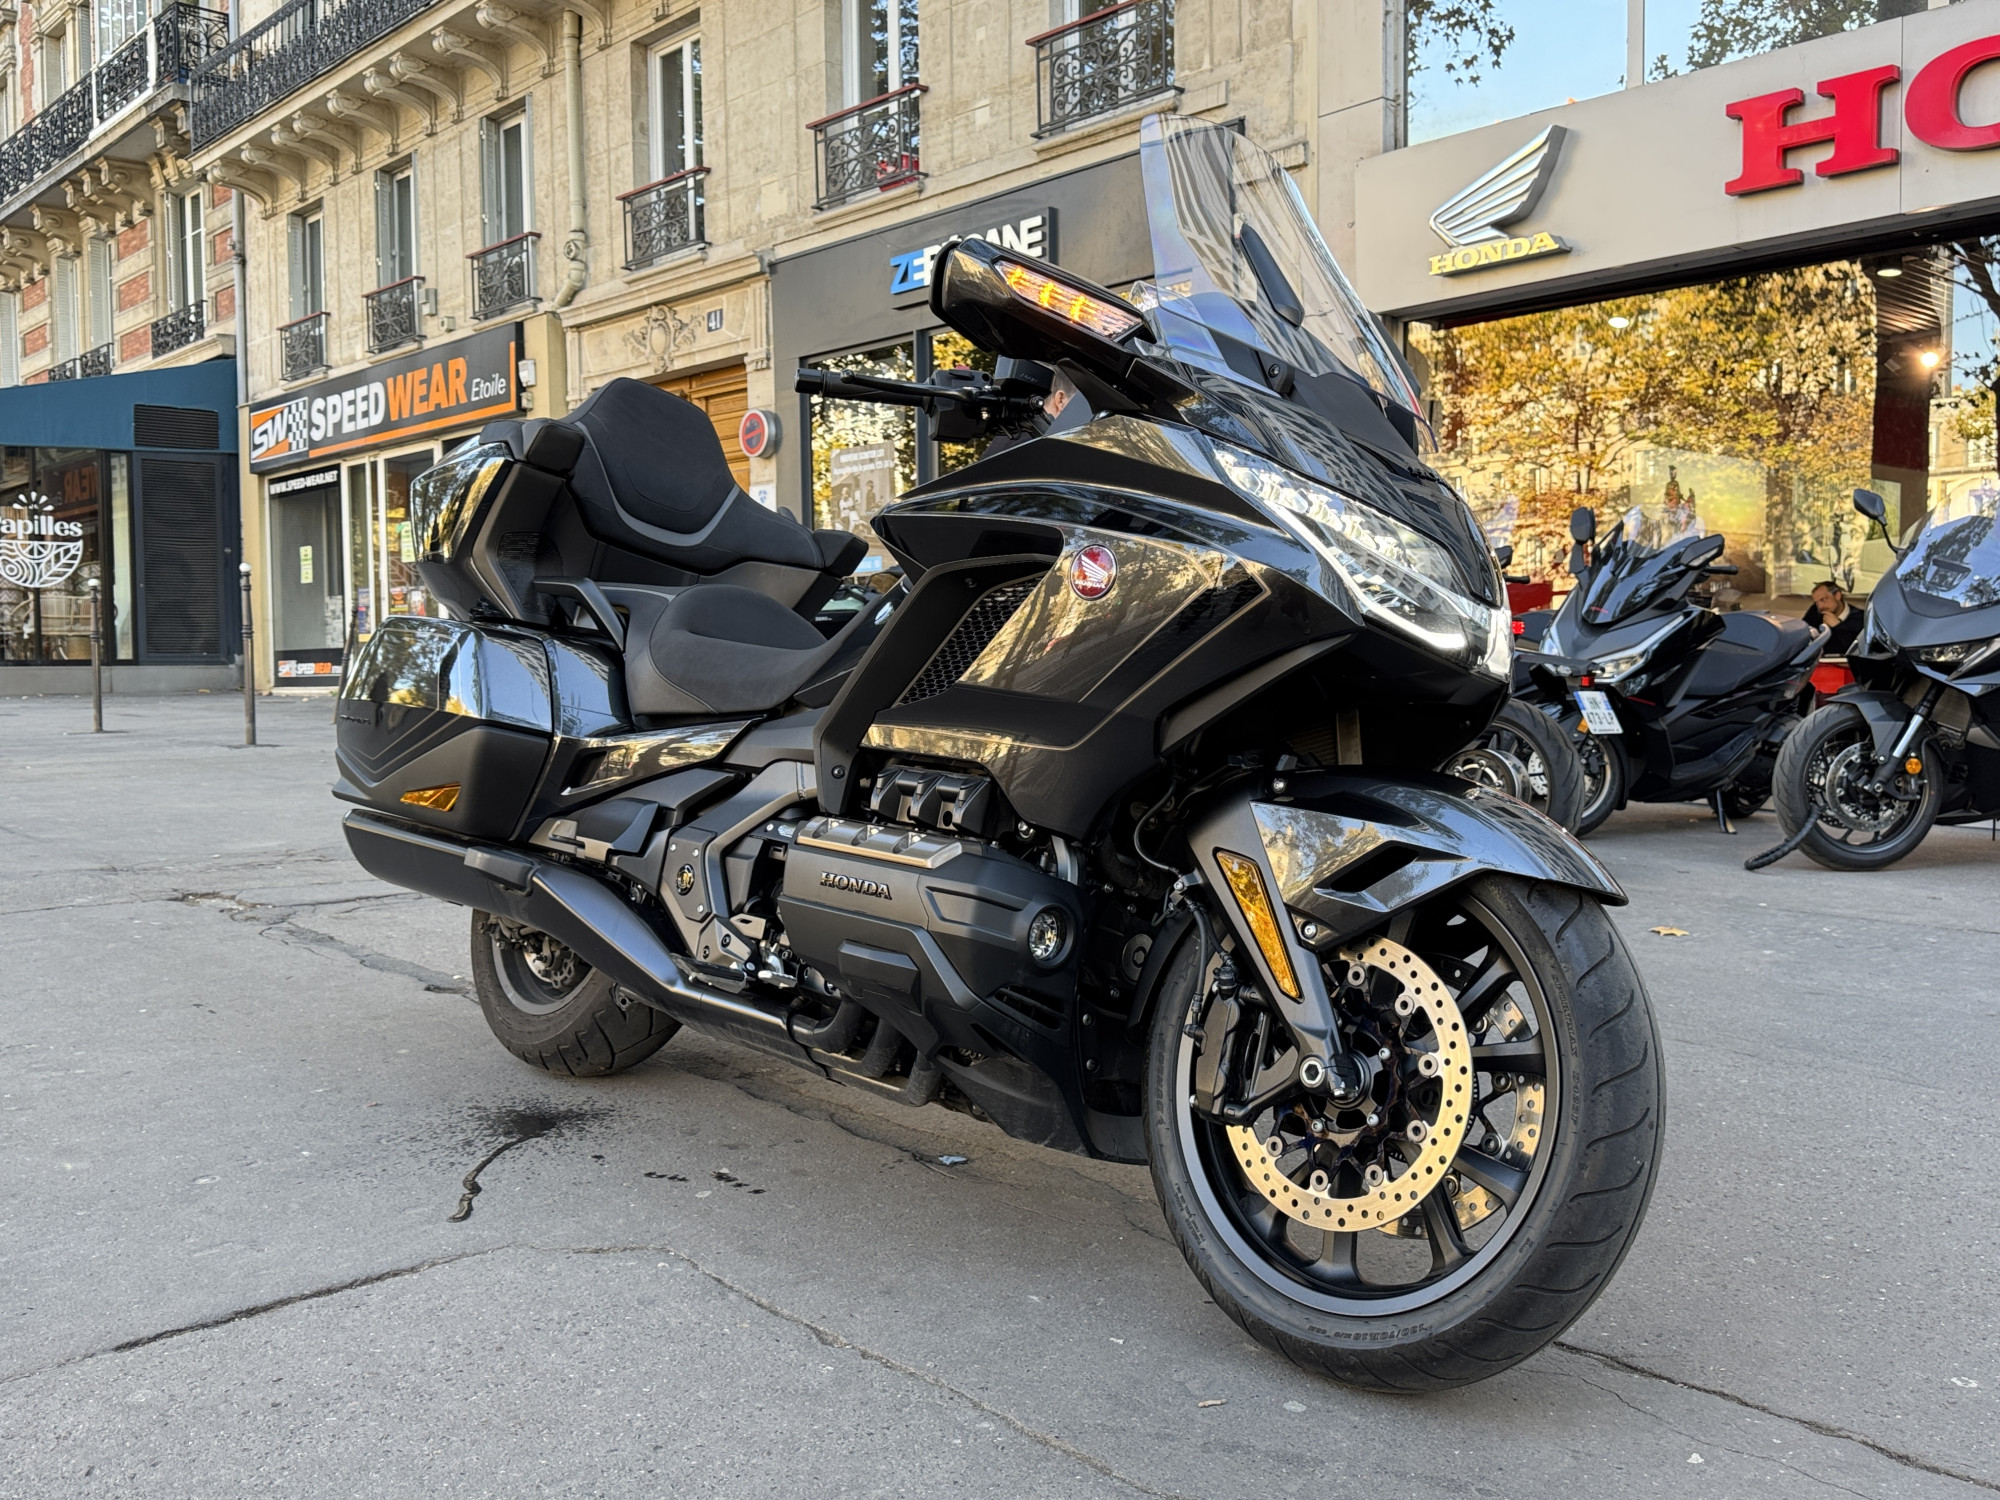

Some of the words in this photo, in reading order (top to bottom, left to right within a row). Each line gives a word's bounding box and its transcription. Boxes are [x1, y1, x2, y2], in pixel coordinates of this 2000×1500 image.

[1429, 231, 1559, 276] HONDA
[708, 310, 721, 331] 41
[471, 372, 507, 402] Etoile
[0, 514, 83, 540] apilles
[820, 871, 893, 900] HONDA
